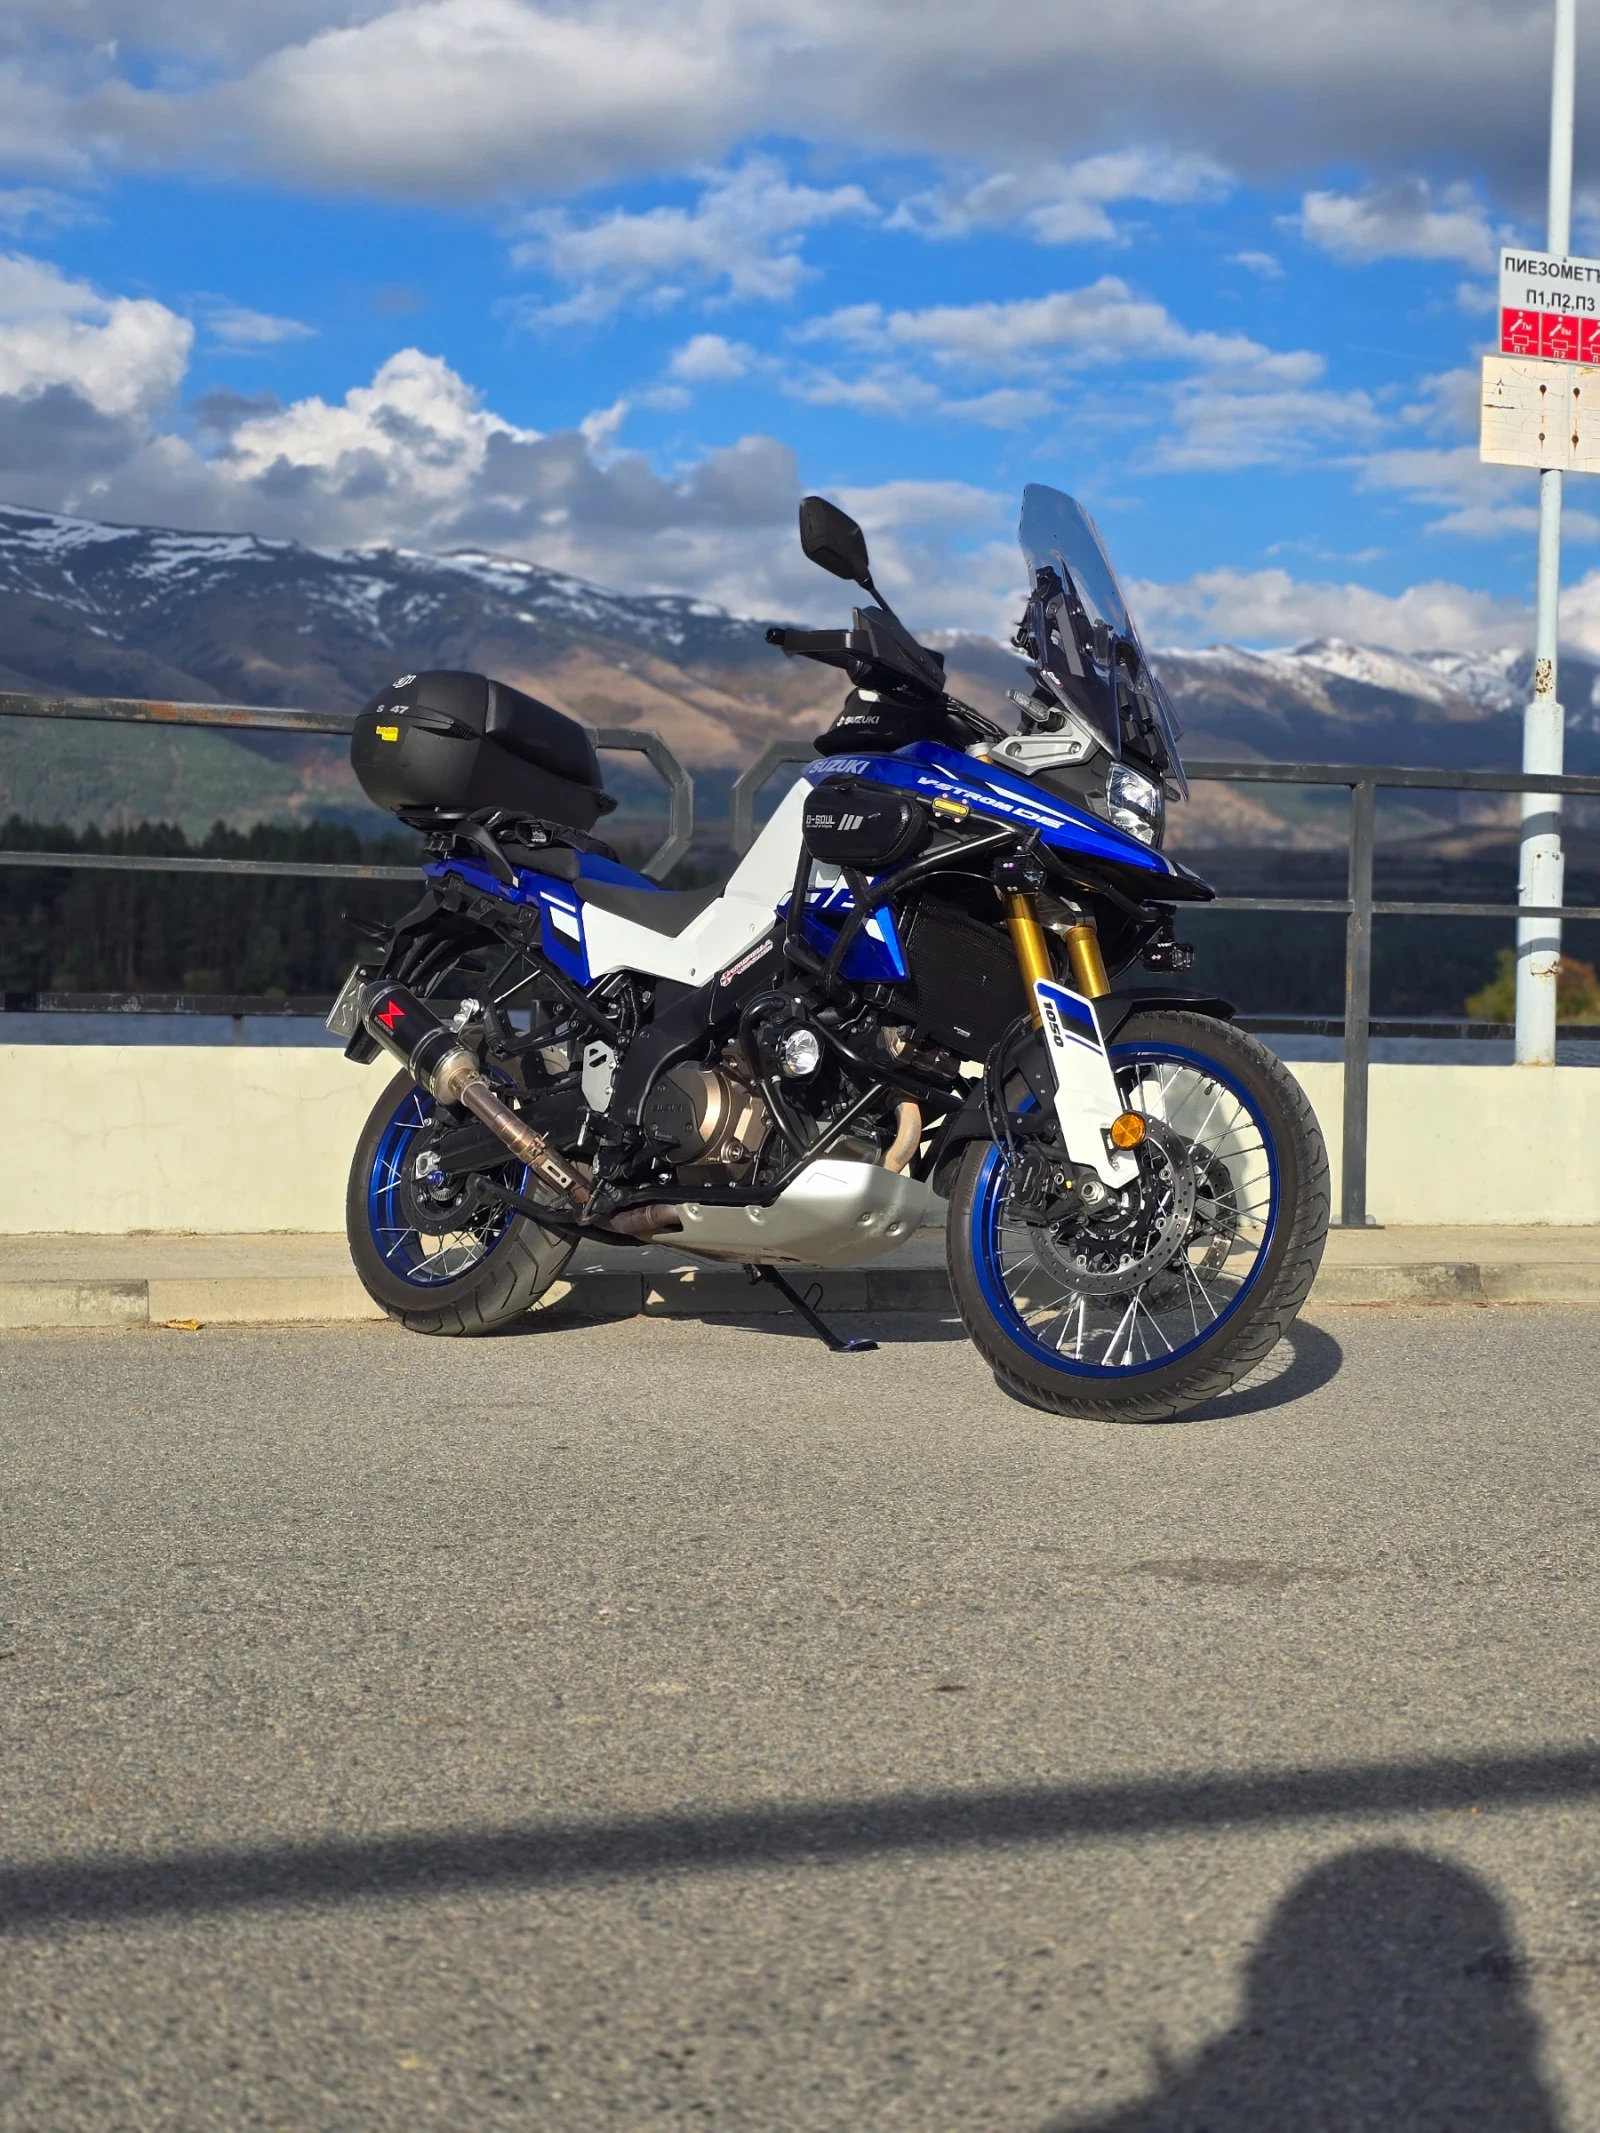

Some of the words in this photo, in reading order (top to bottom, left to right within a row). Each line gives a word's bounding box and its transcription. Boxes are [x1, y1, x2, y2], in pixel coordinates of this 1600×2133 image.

[390, 705, 409, 714] 47
[844, 715, 880, 725] SUZUKI
[808, 759, 871, 775] SUZUKI
[917, 776, 1014, 813] V-STROM
[1043, 1001, 1064, 1048] 1050
